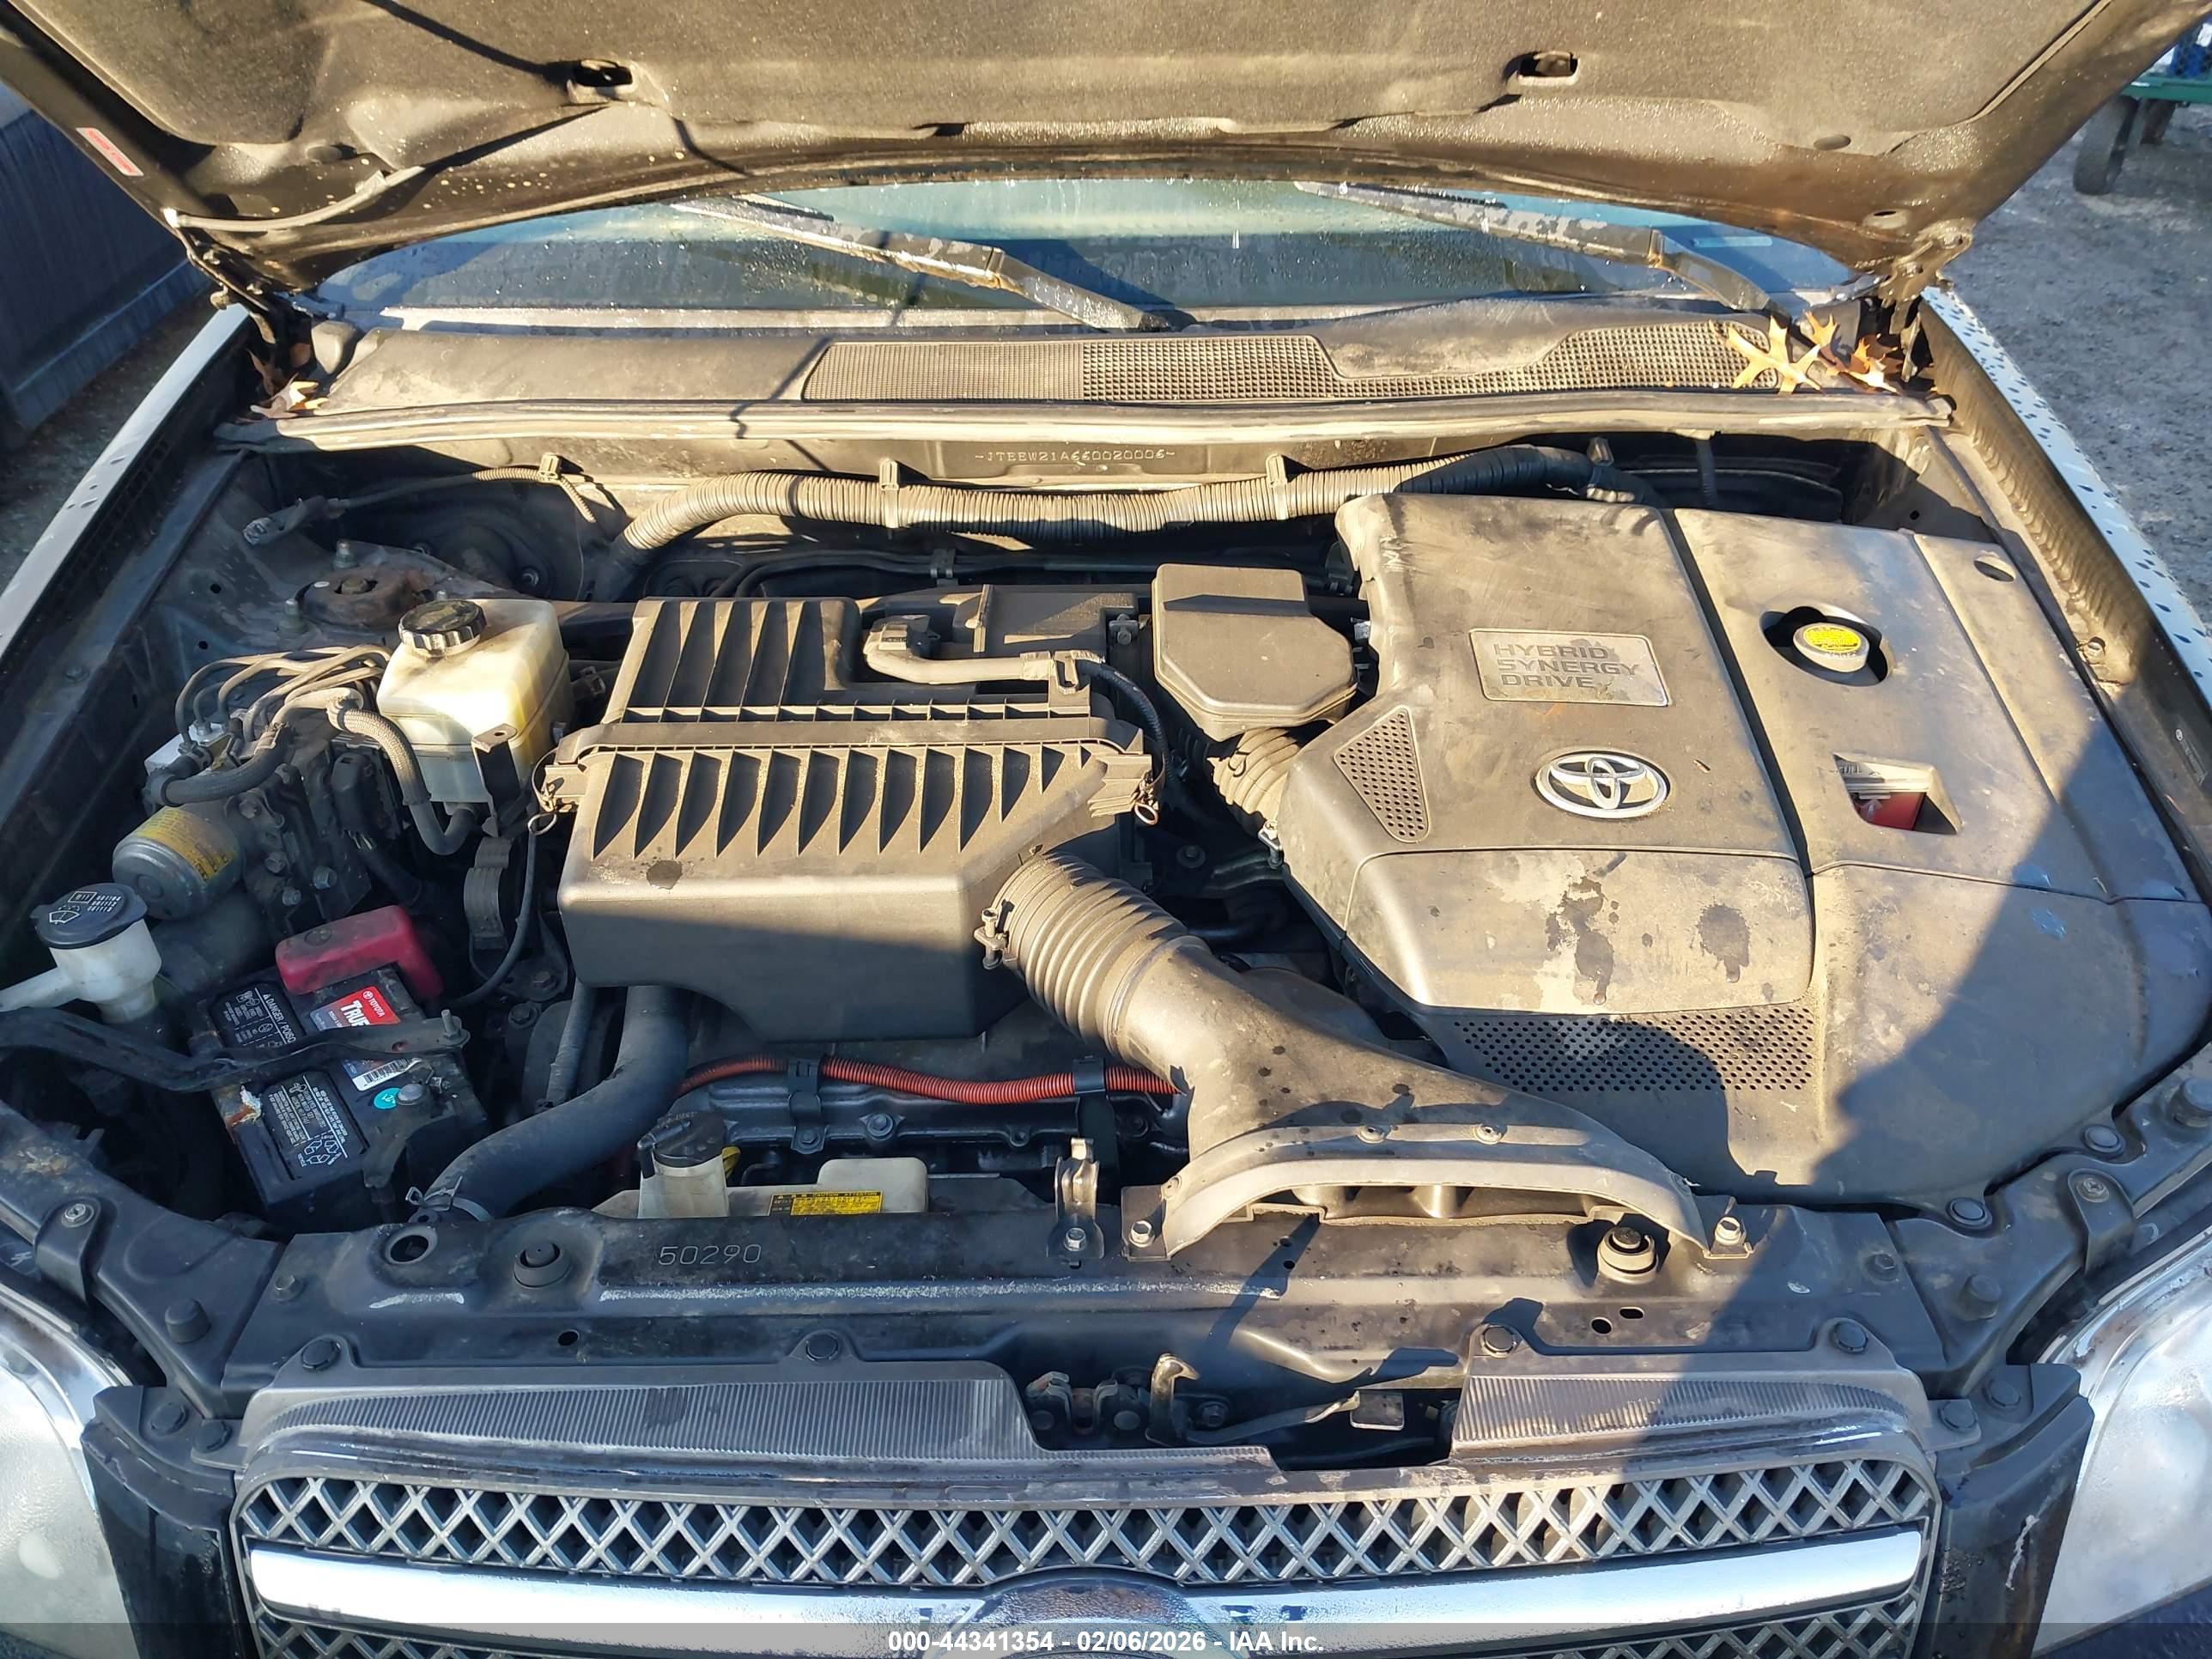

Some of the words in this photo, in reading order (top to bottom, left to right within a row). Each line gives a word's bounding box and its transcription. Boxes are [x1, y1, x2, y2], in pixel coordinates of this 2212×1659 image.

[1493, 644, 1608, 659] HYBRID
[1497, 659, 1639, 676] SYNERGY
[1501, 674, 1597, 688] DRIVE
[368, 998, 386, 1018] TOYOTA
[265, 998, 284, 1023] DANGER
[280, 1024, 297, 1043] POISO
[658, 1244, 762, 1266] 50290
